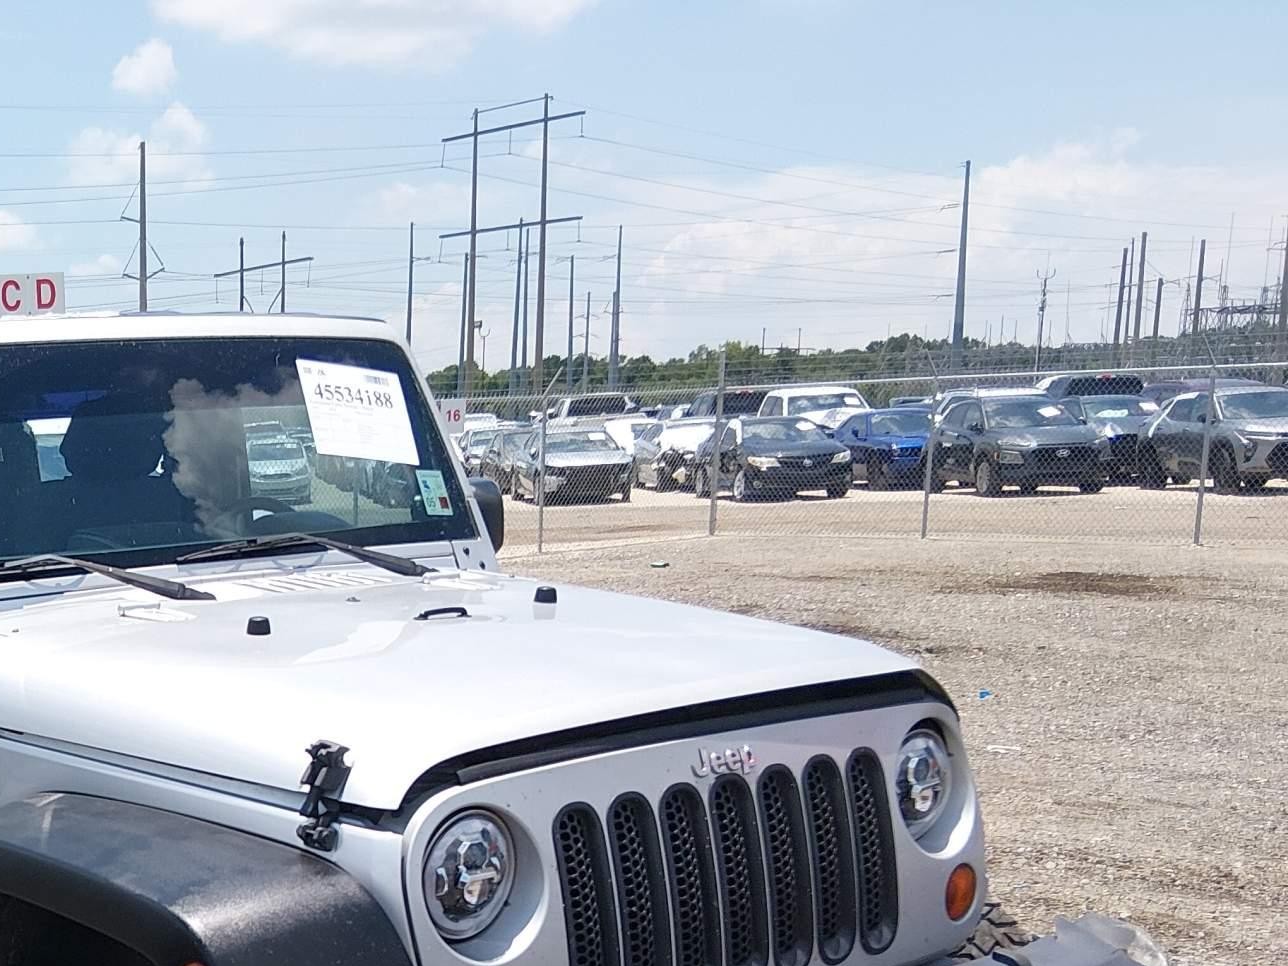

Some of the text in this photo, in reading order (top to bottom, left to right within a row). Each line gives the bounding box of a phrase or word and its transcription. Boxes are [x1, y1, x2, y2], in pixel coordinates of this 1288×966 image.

[1, 278, 56, 312] C D
[314, 383, 393, 409] 45534188
[445, 409, 461, 422] 16
[690, 744, 757, 778] Jeep
